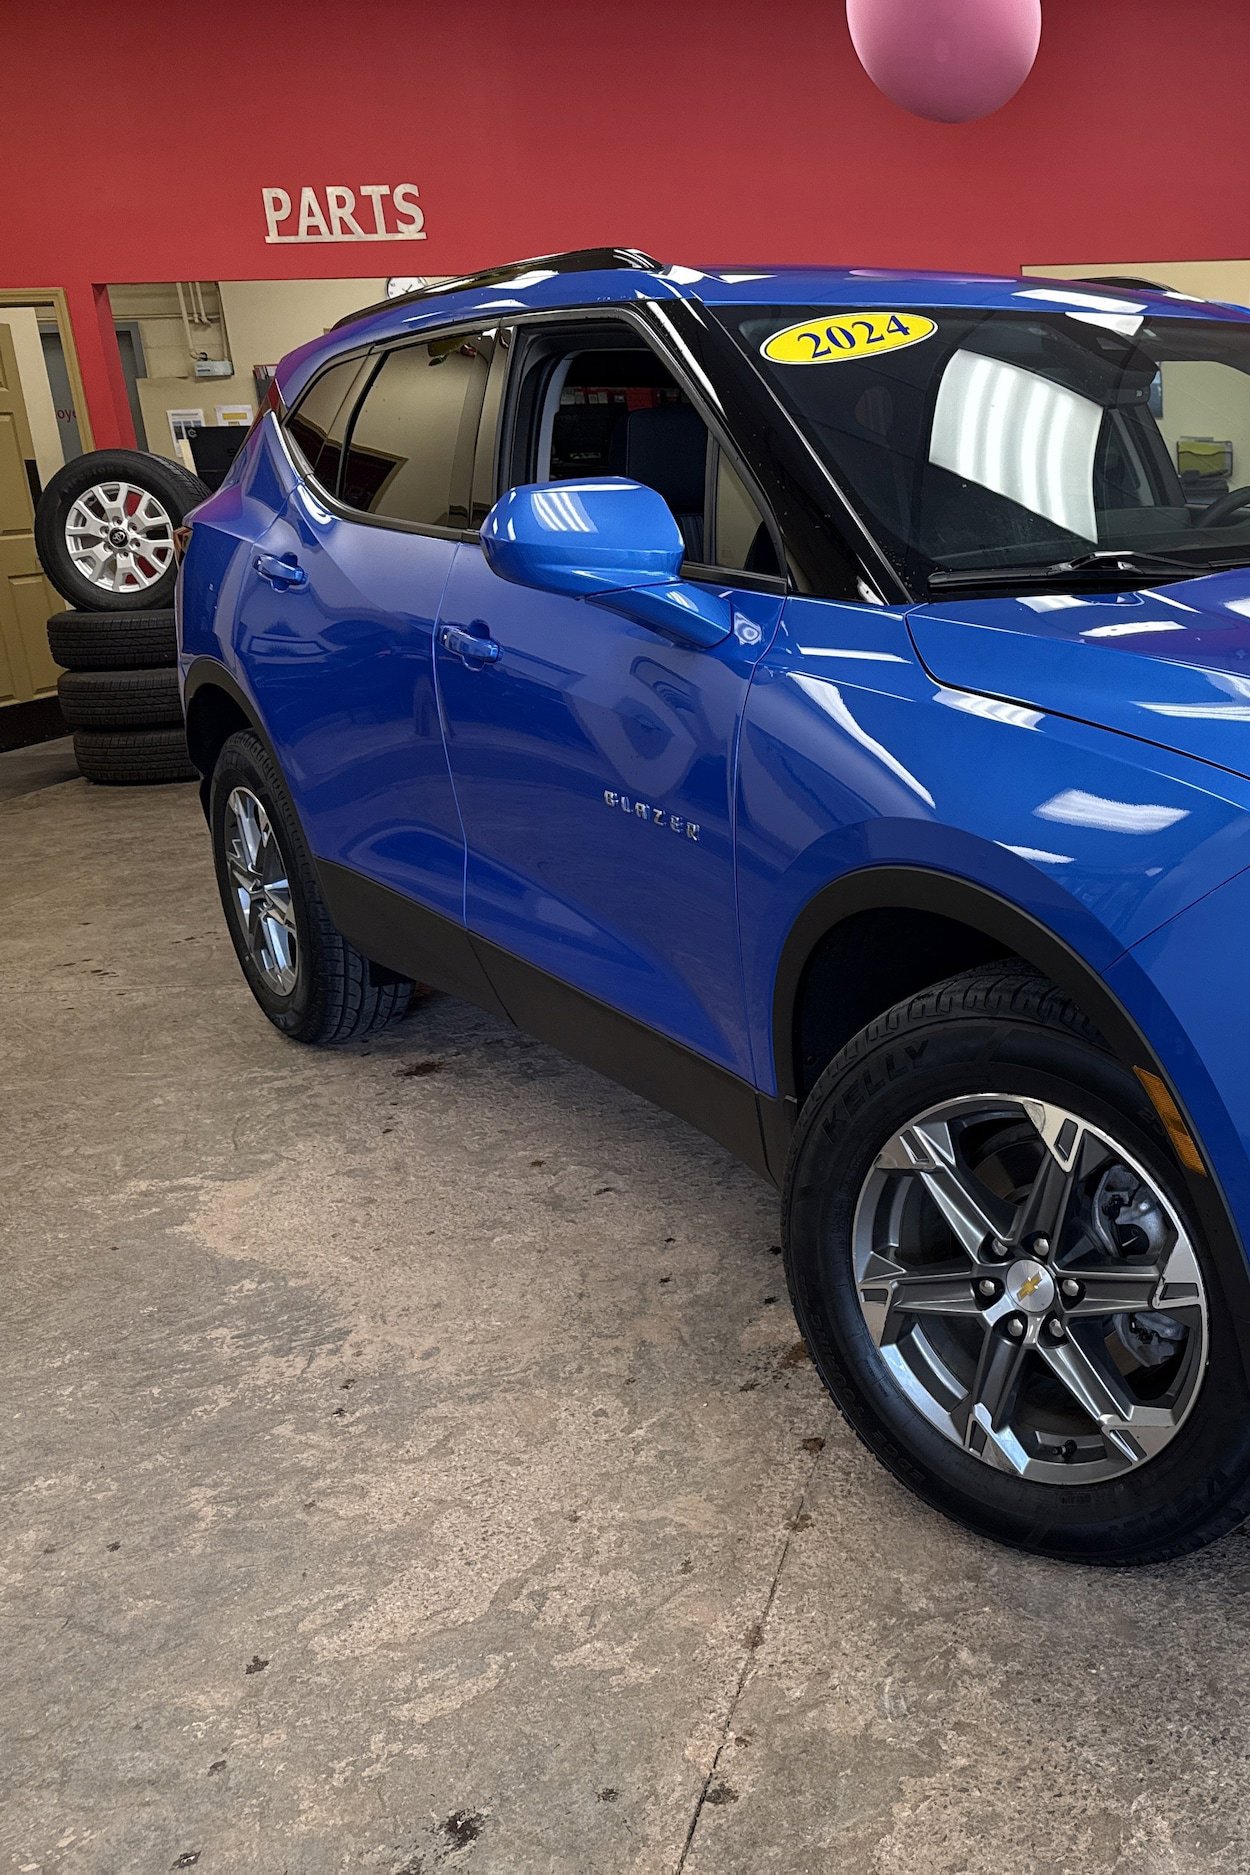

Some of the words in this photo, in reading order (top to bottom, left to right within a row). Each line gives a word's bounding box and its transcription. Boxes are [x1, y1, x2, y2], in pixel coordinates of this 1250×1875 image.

[262, 183, 425, 240] PARTS
[797, 315, 911, 359] 2024
[603, 789, 701, 841] BLAZER
[821, 1039, 929, 1145] KELLY
